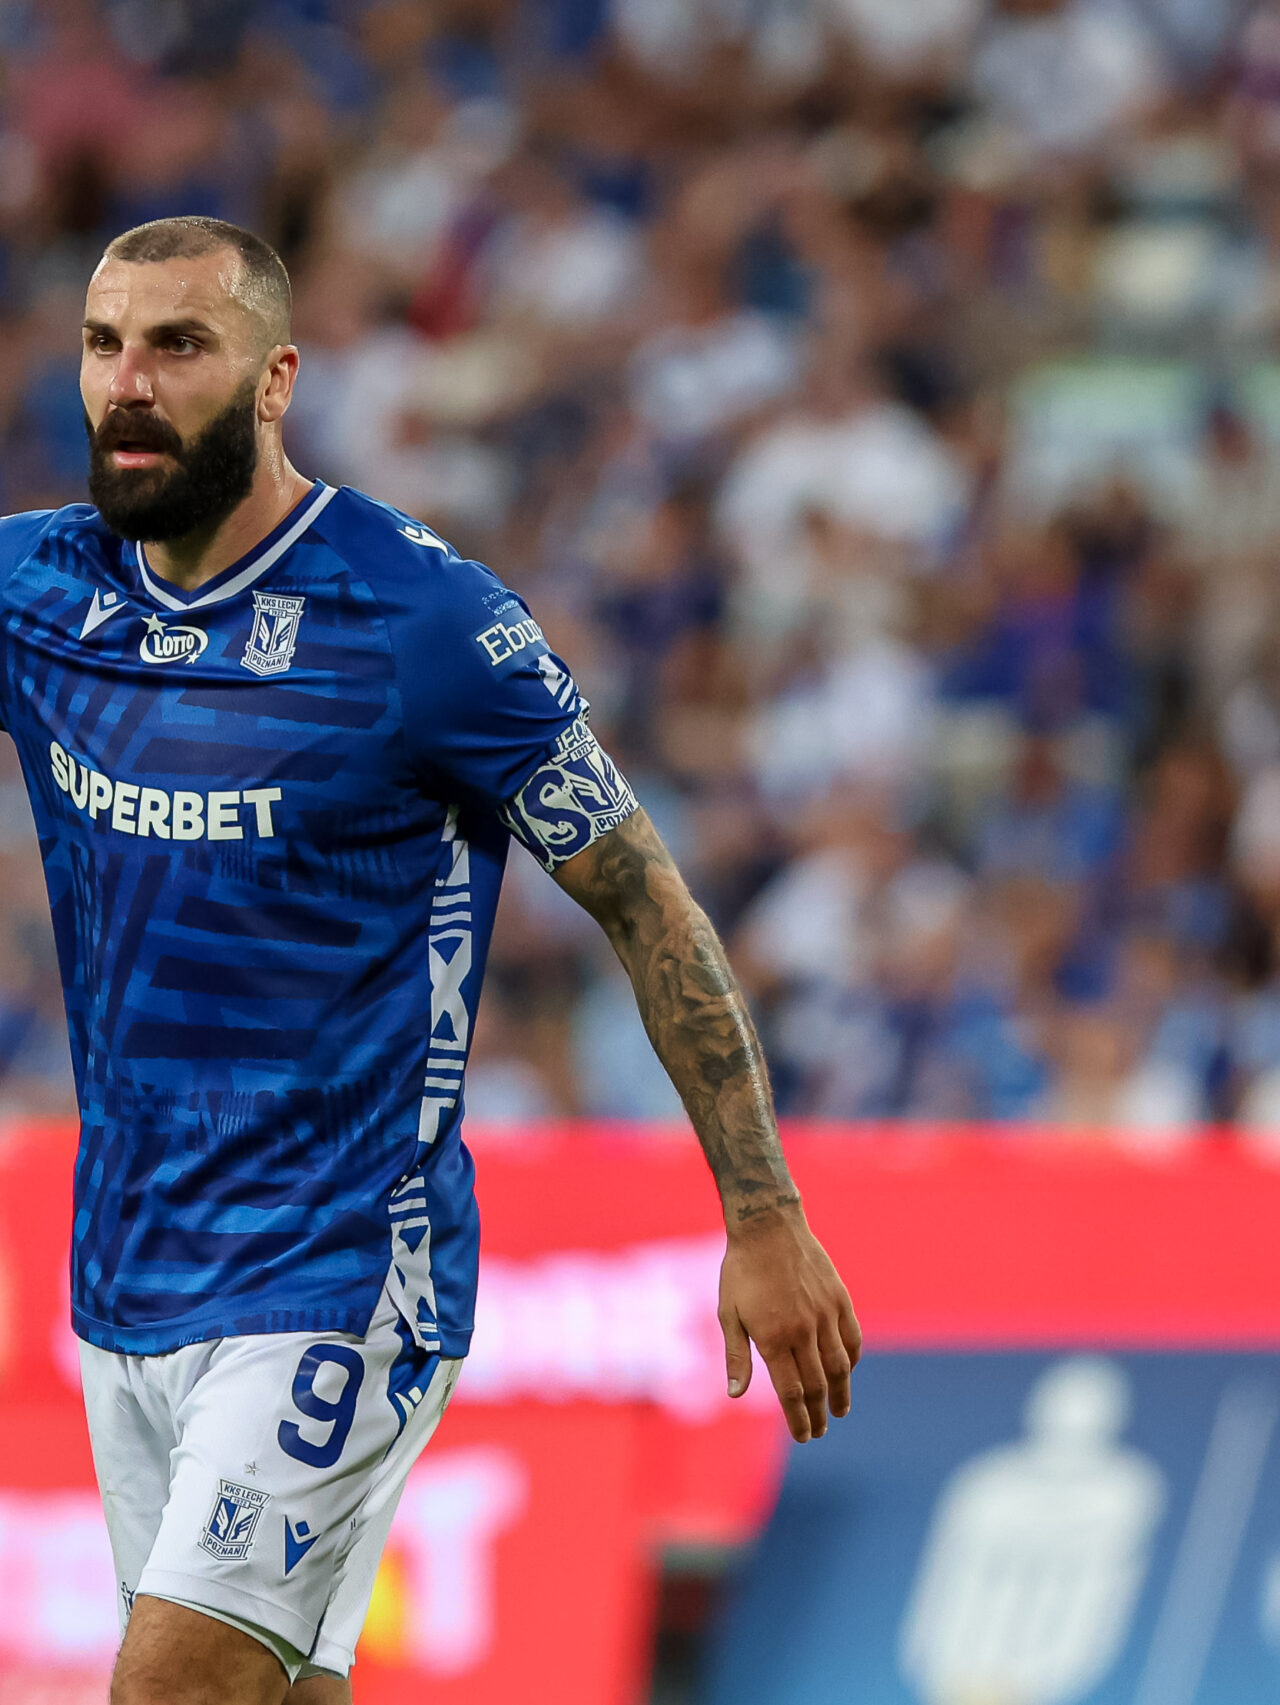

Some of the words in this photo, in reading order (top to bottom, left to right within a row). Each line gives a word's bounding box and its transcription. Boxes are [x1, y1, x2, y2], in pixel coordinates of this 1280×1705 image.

[261, 597, 276, 607] KKS
[277, 599, 297, 610] LECH
[153, 634, 195, 656] LOTTO
[50, 741, 282, 841] SUPERBET
[277, 1343, 365, 1469] 9
[224, 1484, 242, 1496] KKS
[242, 1490, 263, 1503] LECH
